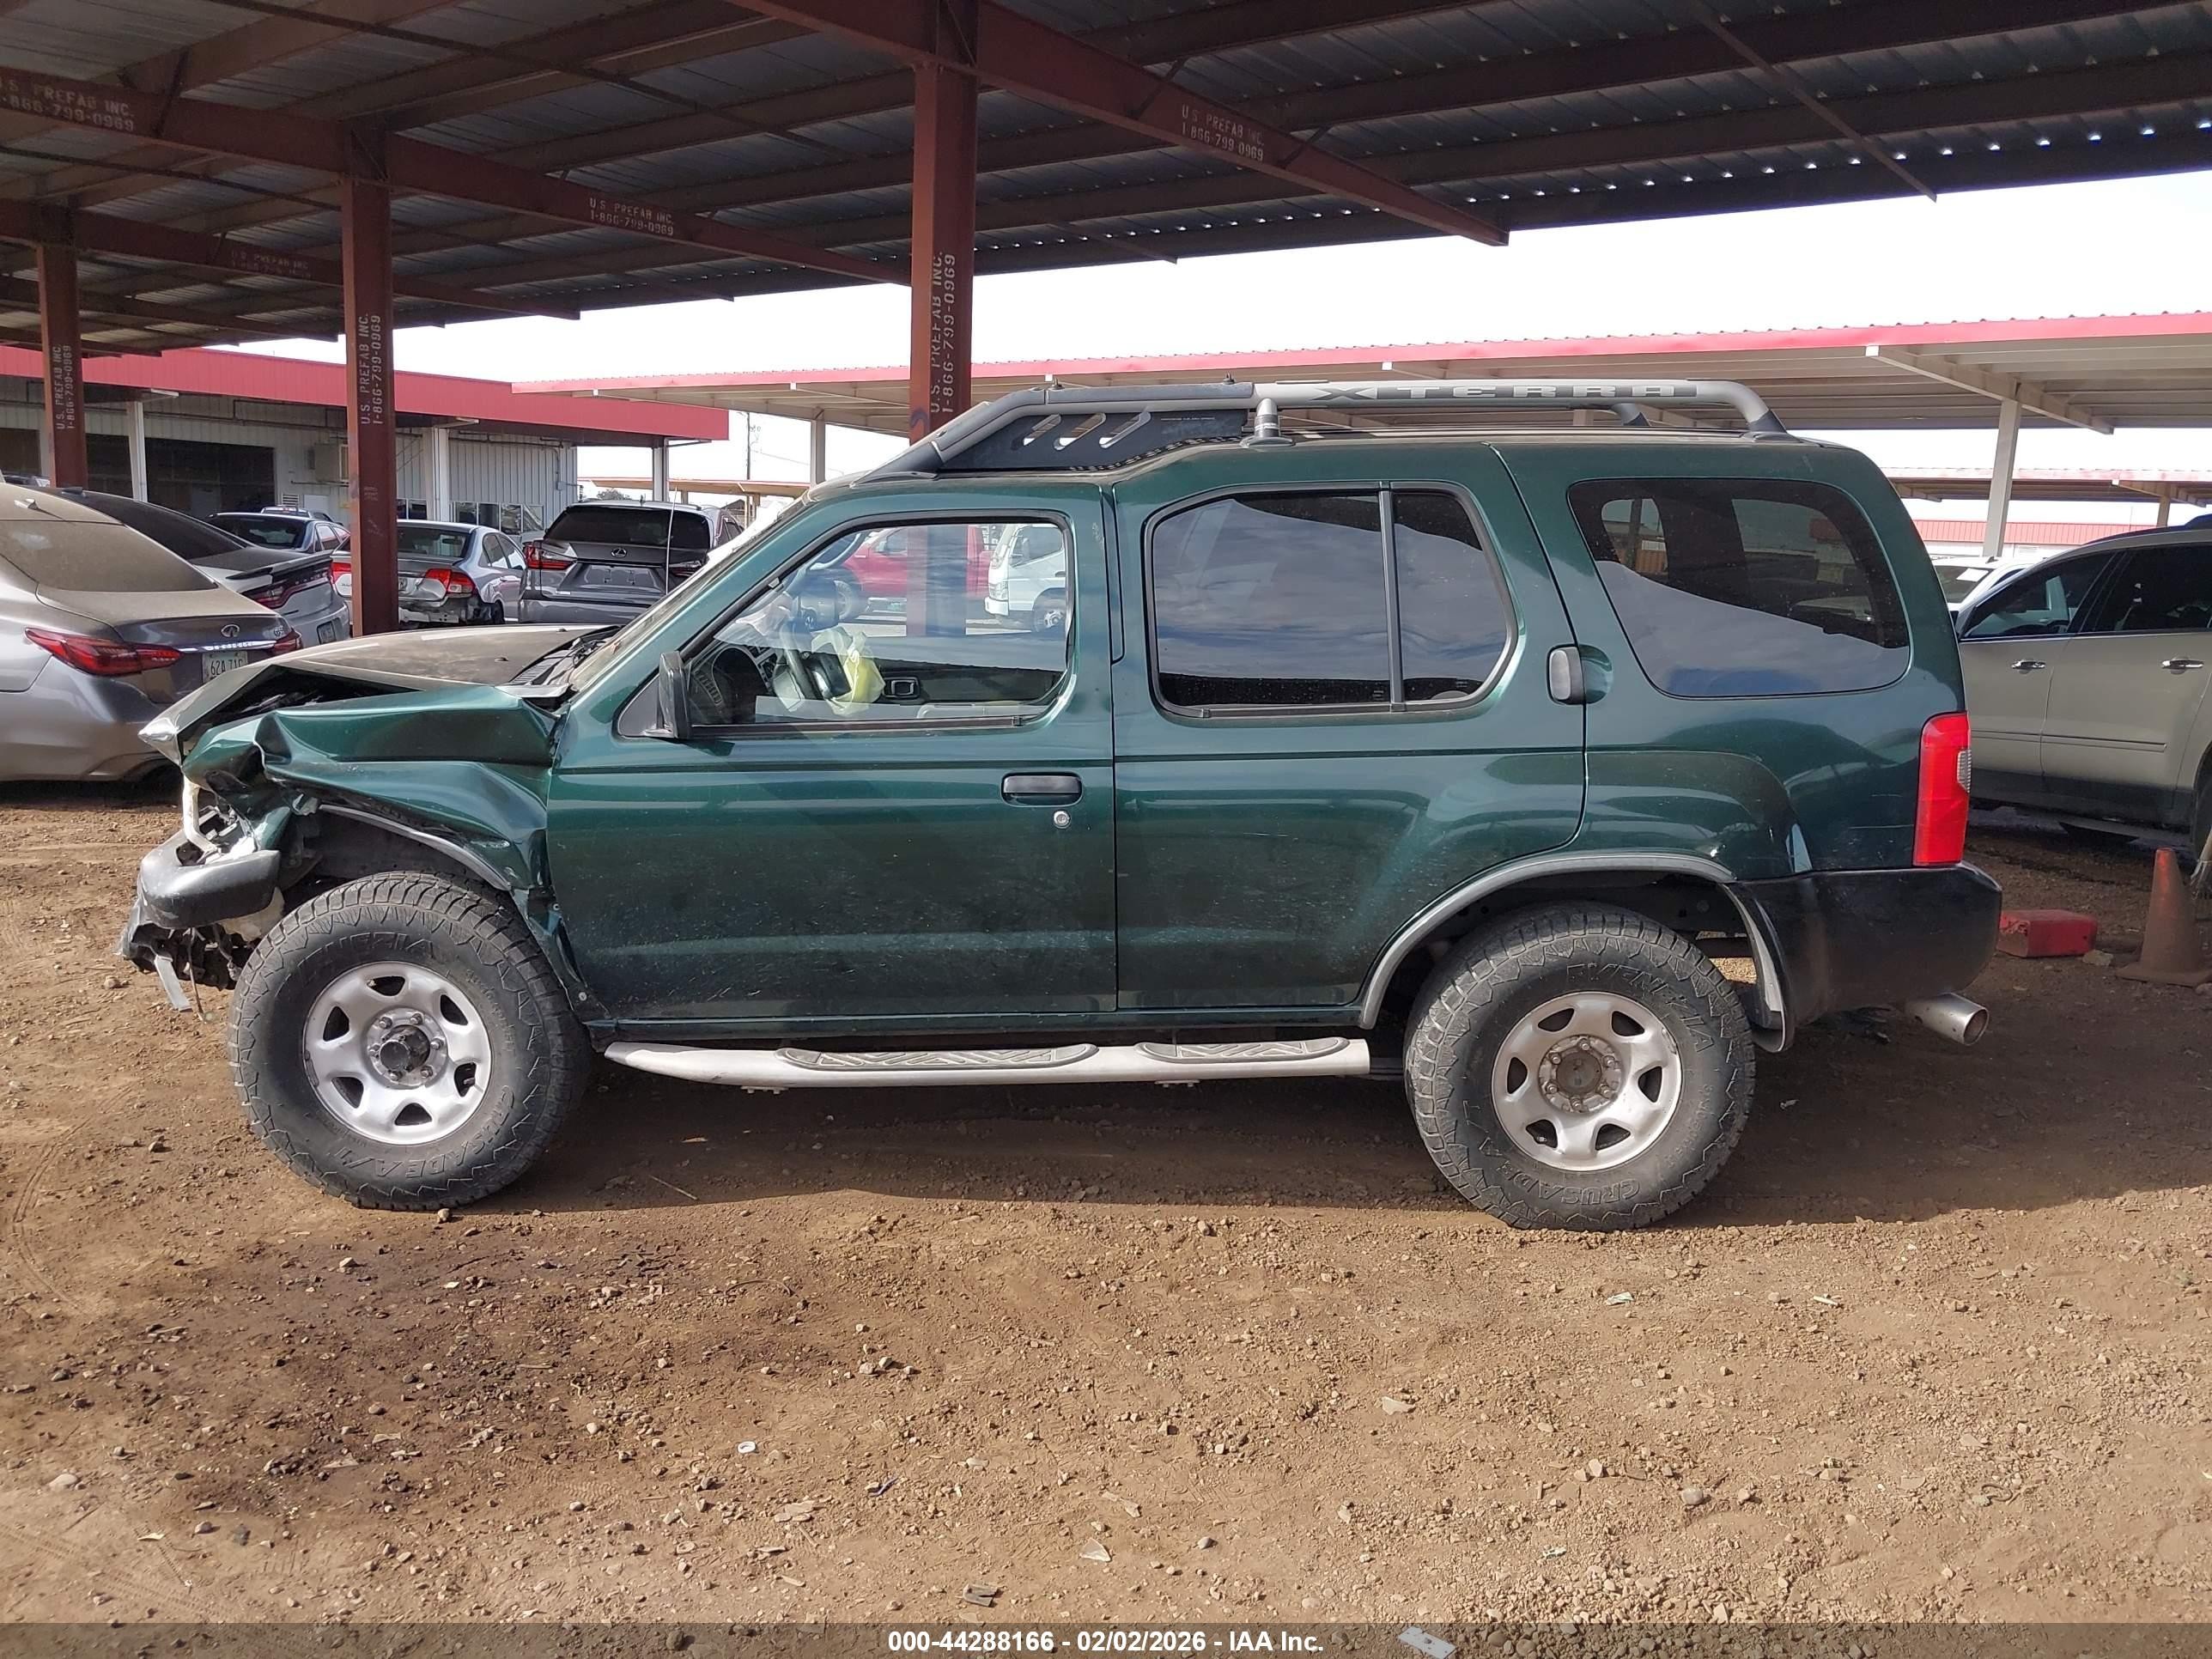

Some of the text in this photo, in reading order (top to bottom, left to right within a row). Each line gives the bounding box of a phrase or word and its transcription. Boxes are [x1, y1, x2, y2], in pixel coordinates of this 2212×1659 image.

[0, 94, 134, 131] -866-799-0969
[1206, 113, 1243, 138] PREFAB
[614, 203, 653, 221] PREFAB
[358, 313, 369, 337] INC.
[943, 254, 956, 413] 1-866-799-0969
[54, 367, 64, 405] PREFAB
[359, 343, 370, 393] PREFAB
[370, 315, 384, 425] 1-866-799-0969
[63, 345, 76, 429] 1-866-799-0969
[1311, 385, 1675, 401] XTERRA
